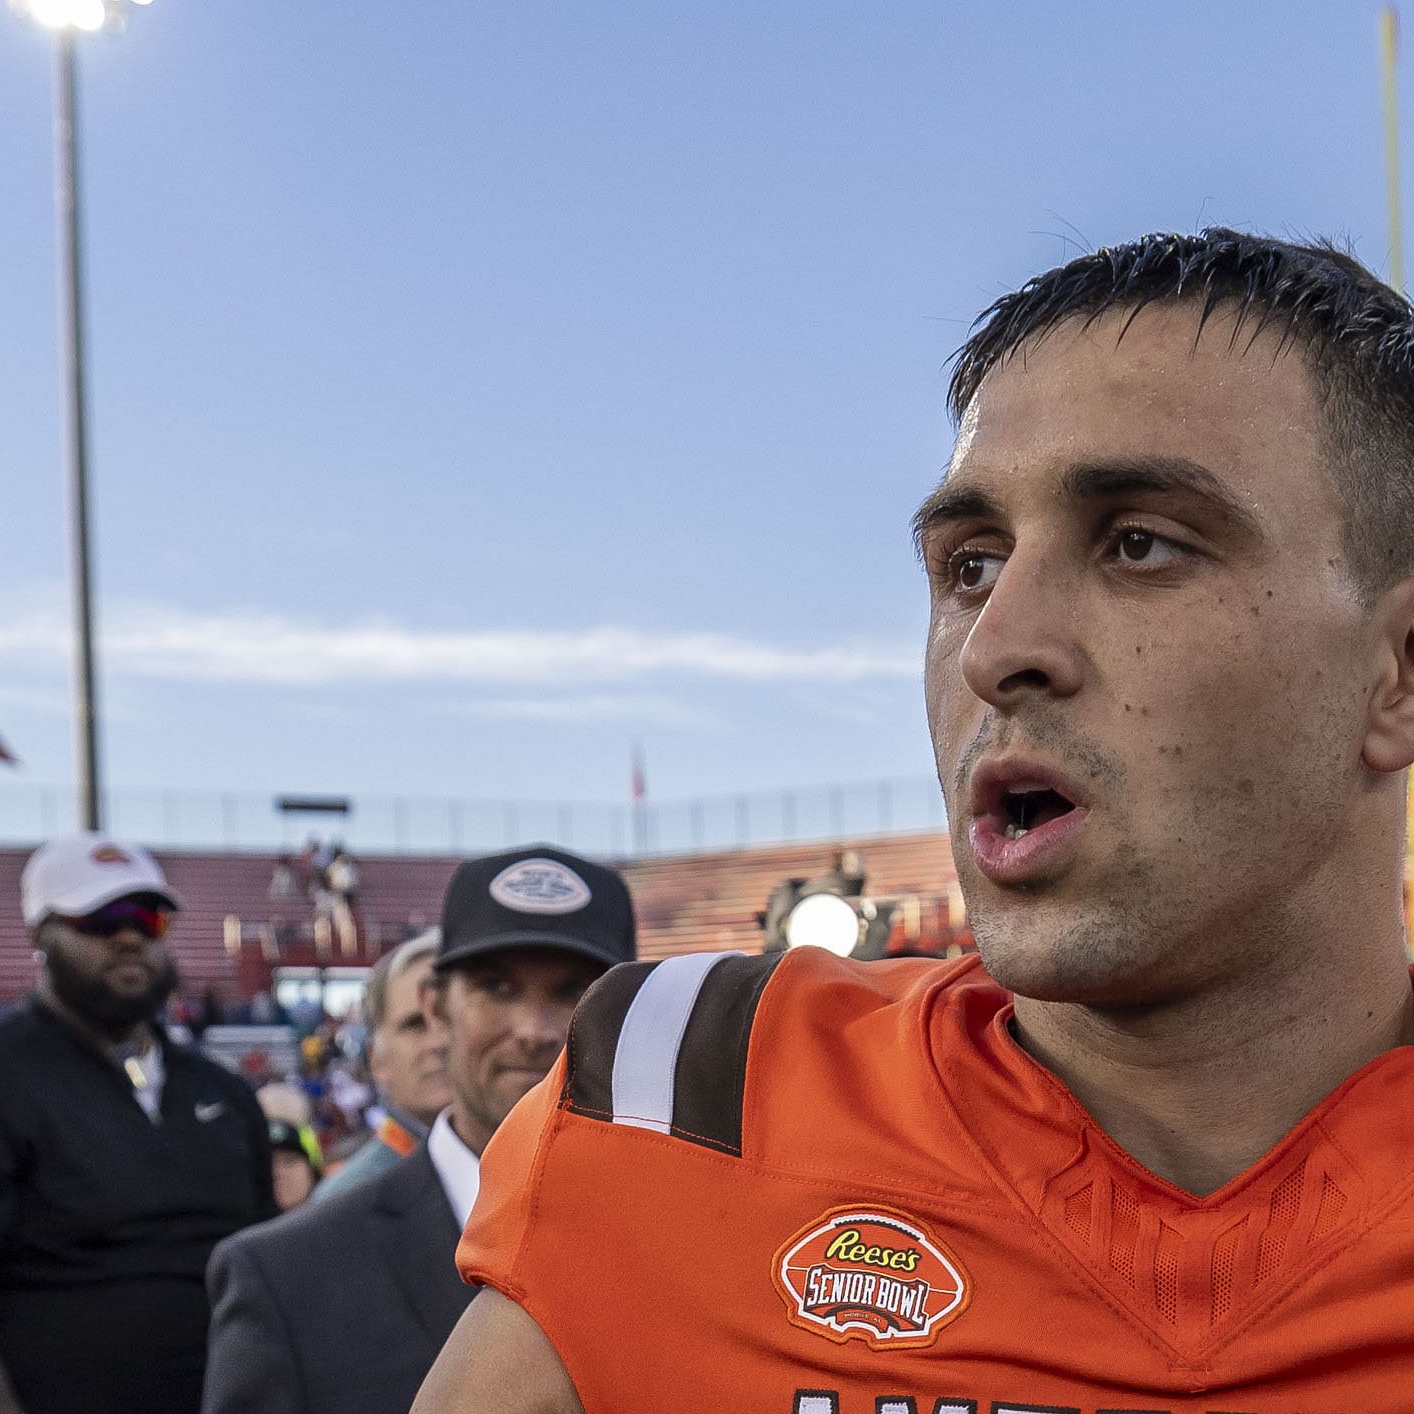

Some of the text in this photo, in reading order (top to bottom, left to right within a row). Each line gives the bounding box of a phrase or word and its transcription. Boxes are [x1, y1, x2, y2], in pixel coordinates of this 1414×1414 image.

[825, 1228, 921, 1272] Reese's
[806, 1265, 926, 1325] SENIOR BOWL
